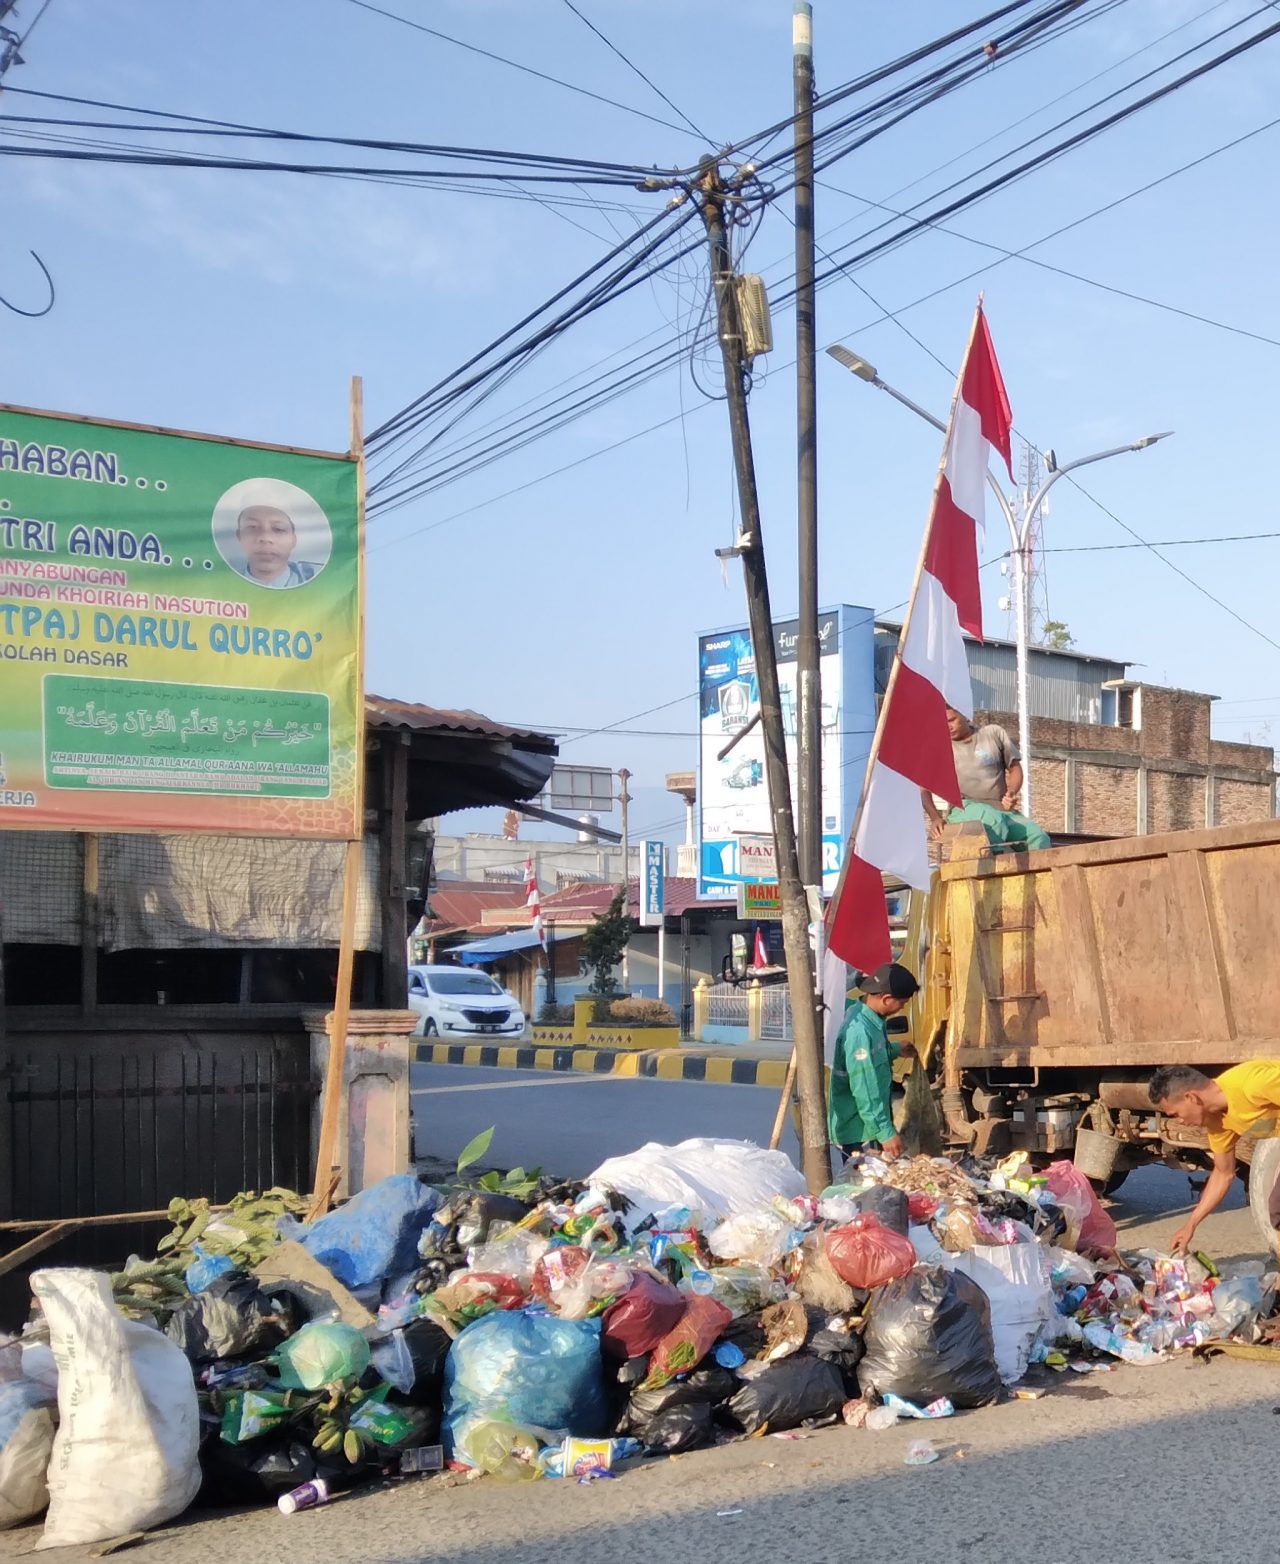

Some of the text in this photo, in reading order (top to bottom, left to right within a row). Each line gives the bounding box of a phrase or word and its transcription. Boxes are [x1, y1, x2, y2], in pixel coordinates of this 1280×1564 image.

[0, 560, 126, 586] NYABUNGAN
[57, 587, 149, 609] KHOIRIAH
[155, 596, 248, 618] NASUTION
[94, 612, 198, 650] DARUL
[0, 644, 129, 667] OLAH DASAR
[705, 640, 731, 651] SHARP
[51, 751, 114, 765] KHAIRUKUM
[115, 755, 140, 766] MAN
[257, 761, 274, 772] WA
